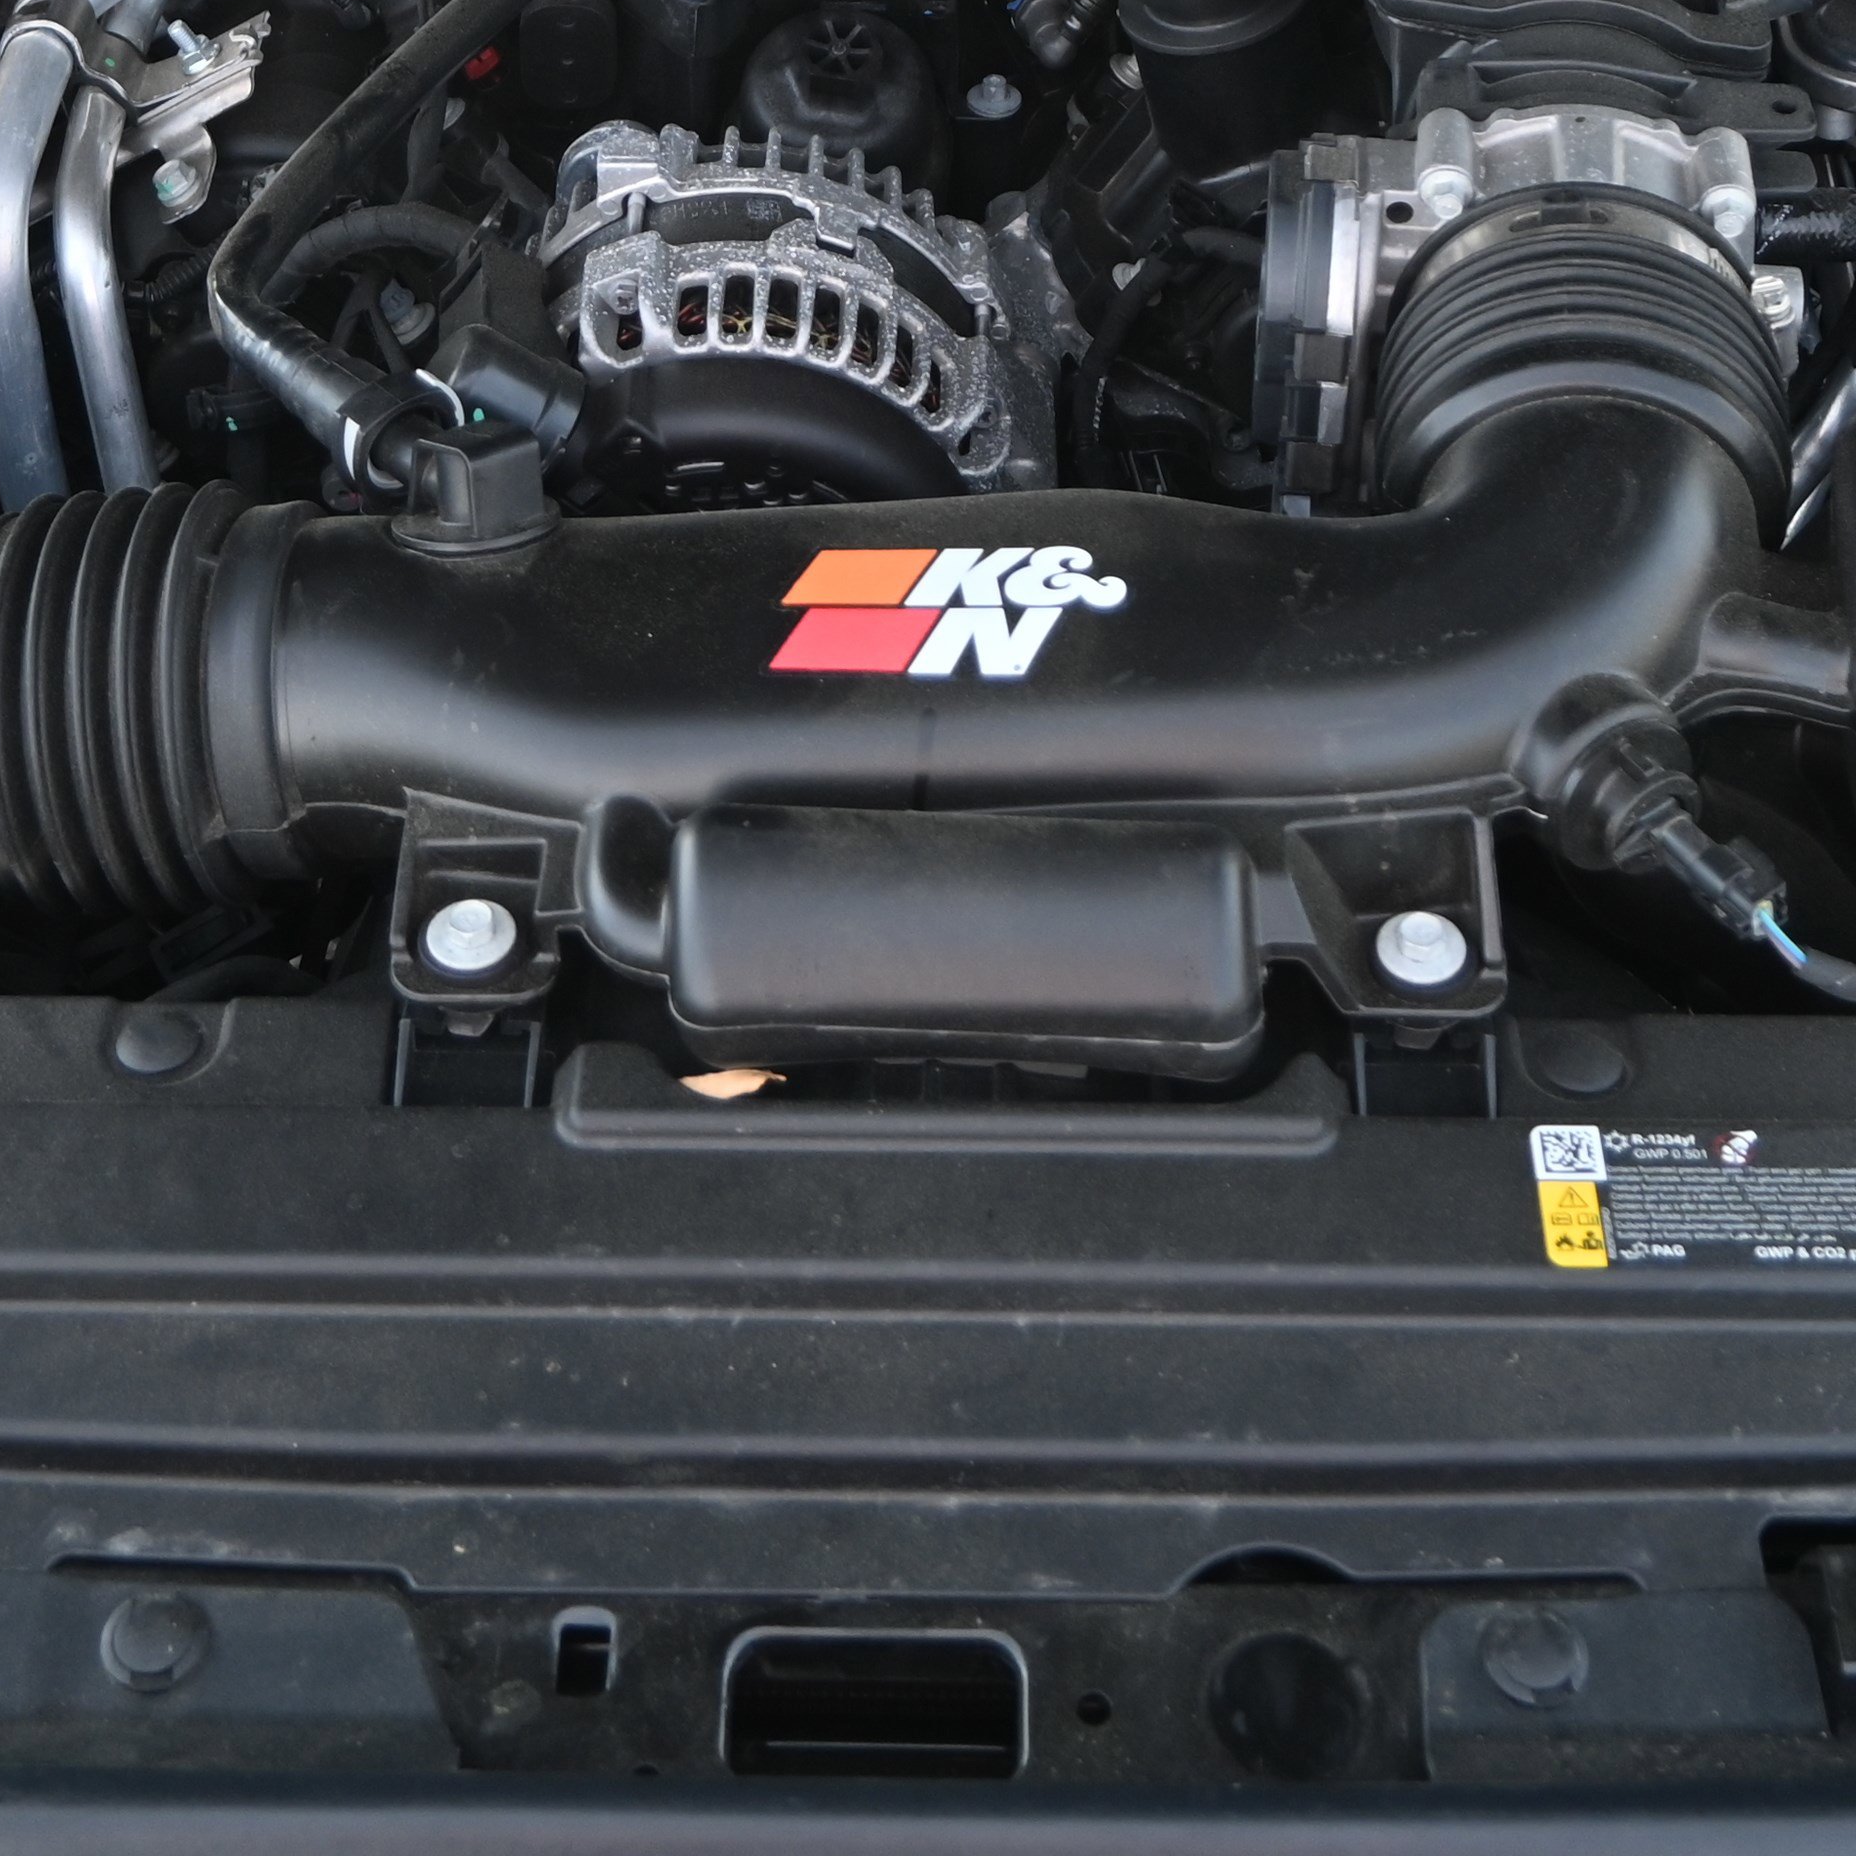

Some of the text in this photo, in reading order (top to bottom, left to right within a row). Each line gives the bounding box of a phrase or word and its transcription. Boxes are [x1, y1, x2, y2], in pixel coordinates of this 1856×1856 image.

[1633, 1148, 1669, 1160] GWP
[1651, 1244, 1686, 1257] PAG
[1754, 1245, 1794, 1259] GWP
[1797, 1246, 1810, 1258] &
[1811, 1246, 1846, 1259] CO2
